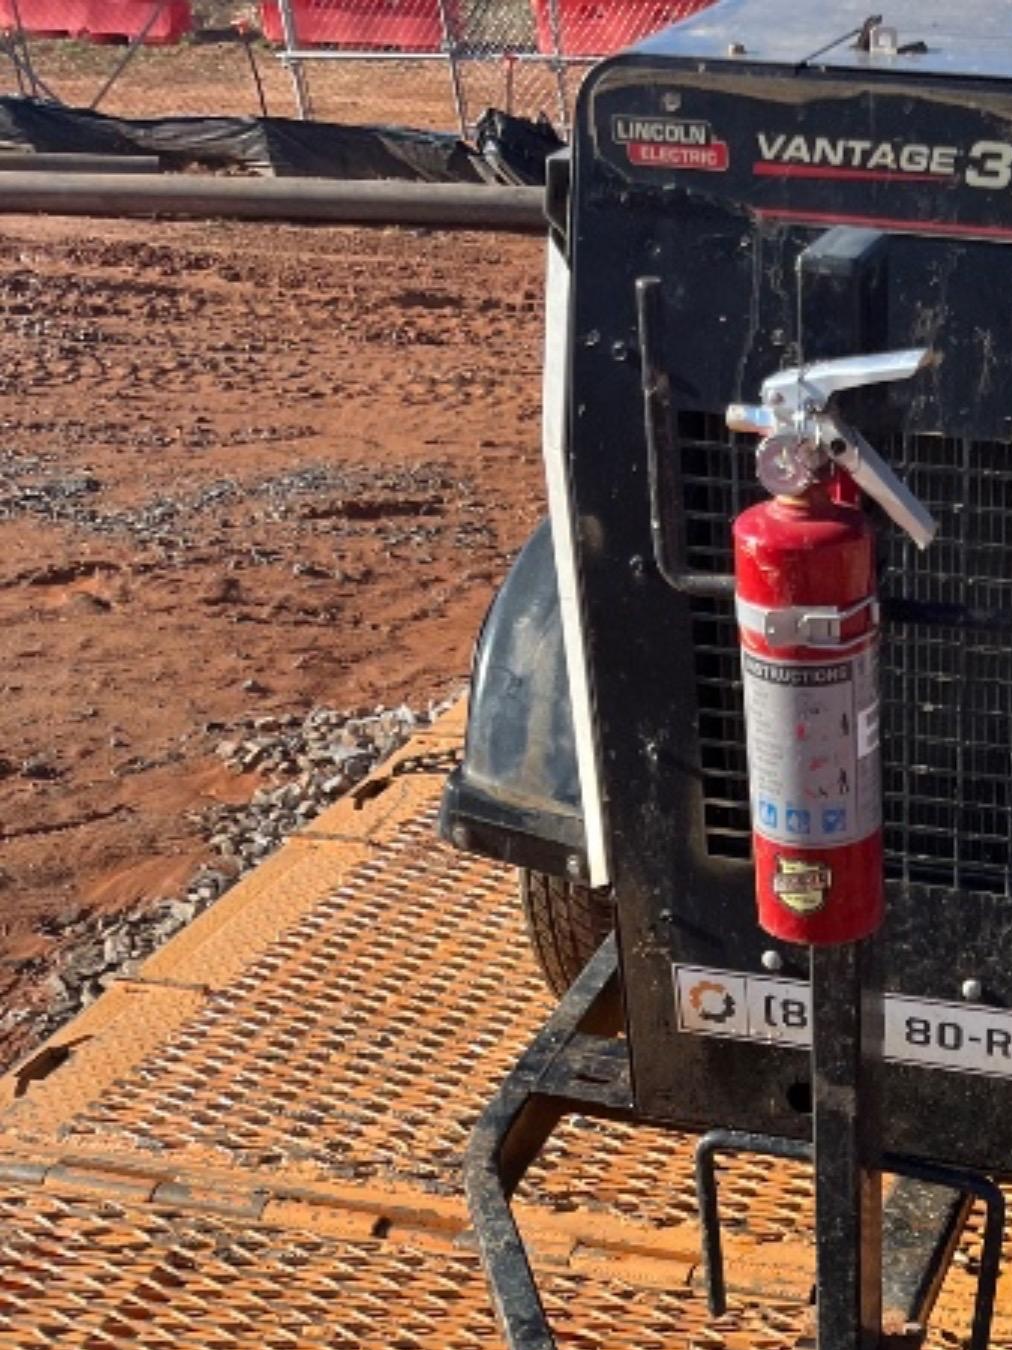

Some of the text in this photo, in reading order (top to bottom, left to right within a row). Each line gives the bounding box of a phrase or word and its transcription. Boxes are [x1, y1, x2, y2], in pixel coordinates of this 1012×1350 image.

[616, 121, 707, 145] LINCOLN
[640, 146, 718, 166] ELECTRIC
[757, 132, 958, 174] VANTAGE
